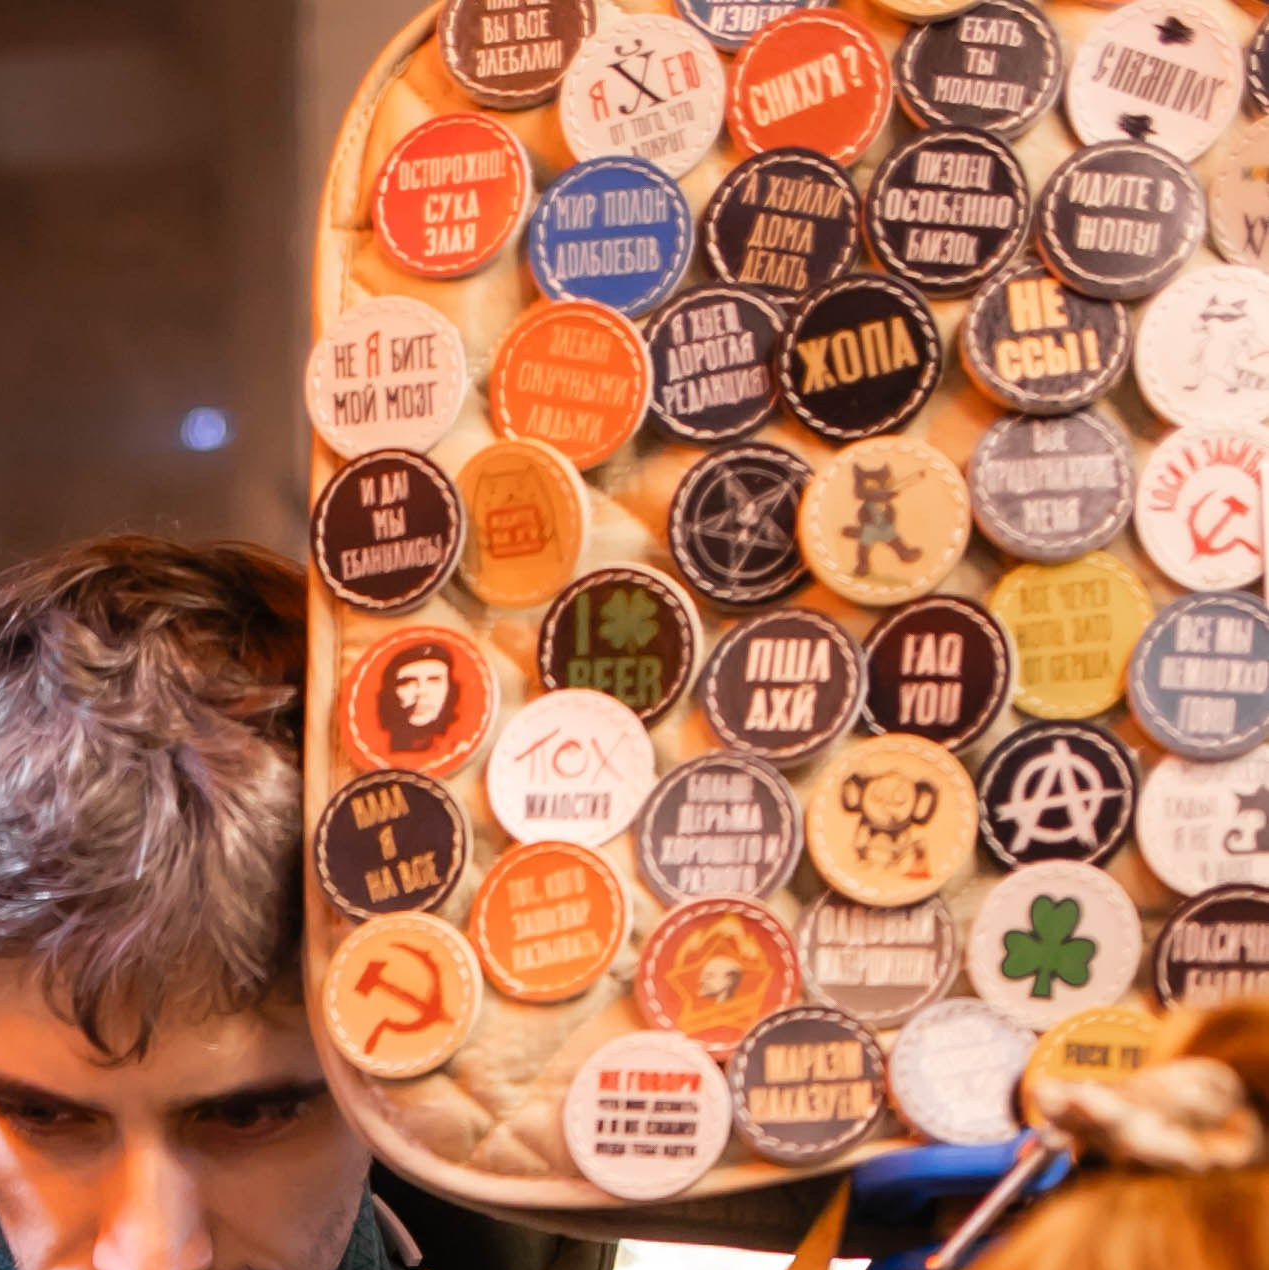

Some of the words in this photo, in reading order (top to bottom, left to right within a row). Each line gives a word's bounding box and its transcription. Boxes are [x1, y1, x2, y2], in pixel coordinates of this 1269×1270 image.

[482, 17, 508, 44] ВЫ
[515, 10, 551, 41] ВСЕ
[958, 16, 1024, 47] ЕБАТЬ
[476, 40, 562, 78] ЗАЕБАЛИ!
[964, 47, 997, 76] ТЫ
[398, 148, 507, 192] ОСТОРОЖНО!
[914, 150, 994, 189] ПИЗДЕЦ
[424, 192, 480, 225] СУКА
[554, 192, 597, 231] МИР
[603, 185, 668, 226] ПОЛОН
[763, 175, 844, 220] ХУЙЛИ
[883, 186, 1013, 229] ОСОБЕННО
[1067, 169, 1152, 213] ИДИТЕ
[1159, 181, 1178, 214] В
[423, 225, 476, 257] ЗЛАЯ
[746, 212, 815, 253] ДОМА
[905, 228, 980, 266] БЛИЗОК
[1075, 214, 1161, 254] ЖОПУ!
[554, 236, 661, 281] ДОЛБОЕБОВ
[737, 249, 809, 292] ДЕЛАТЬ
[1006, 277, 1069, 333] НЕ
[333, 344, 355, 378] НЕ
[390, 333, 438, 370] БИТЕ
[667, 331, 755, 382] ДОРОГАЯ
[797, 315, 919, 395] ЖОПА
[994, 329, 1101, 384] ССЫ!
[332, 383, 377, 427] МОЙ
[385, 381, 438, 420] МОЗГ
[661, 364, 770, 416] РЕДАКЦИЯ
[360, 477, 376, 507] И
[372, 505, 406, 541] МЫ
[901, 632, 964, 677] FAQ
[898, 681, 963, 726] YOU
